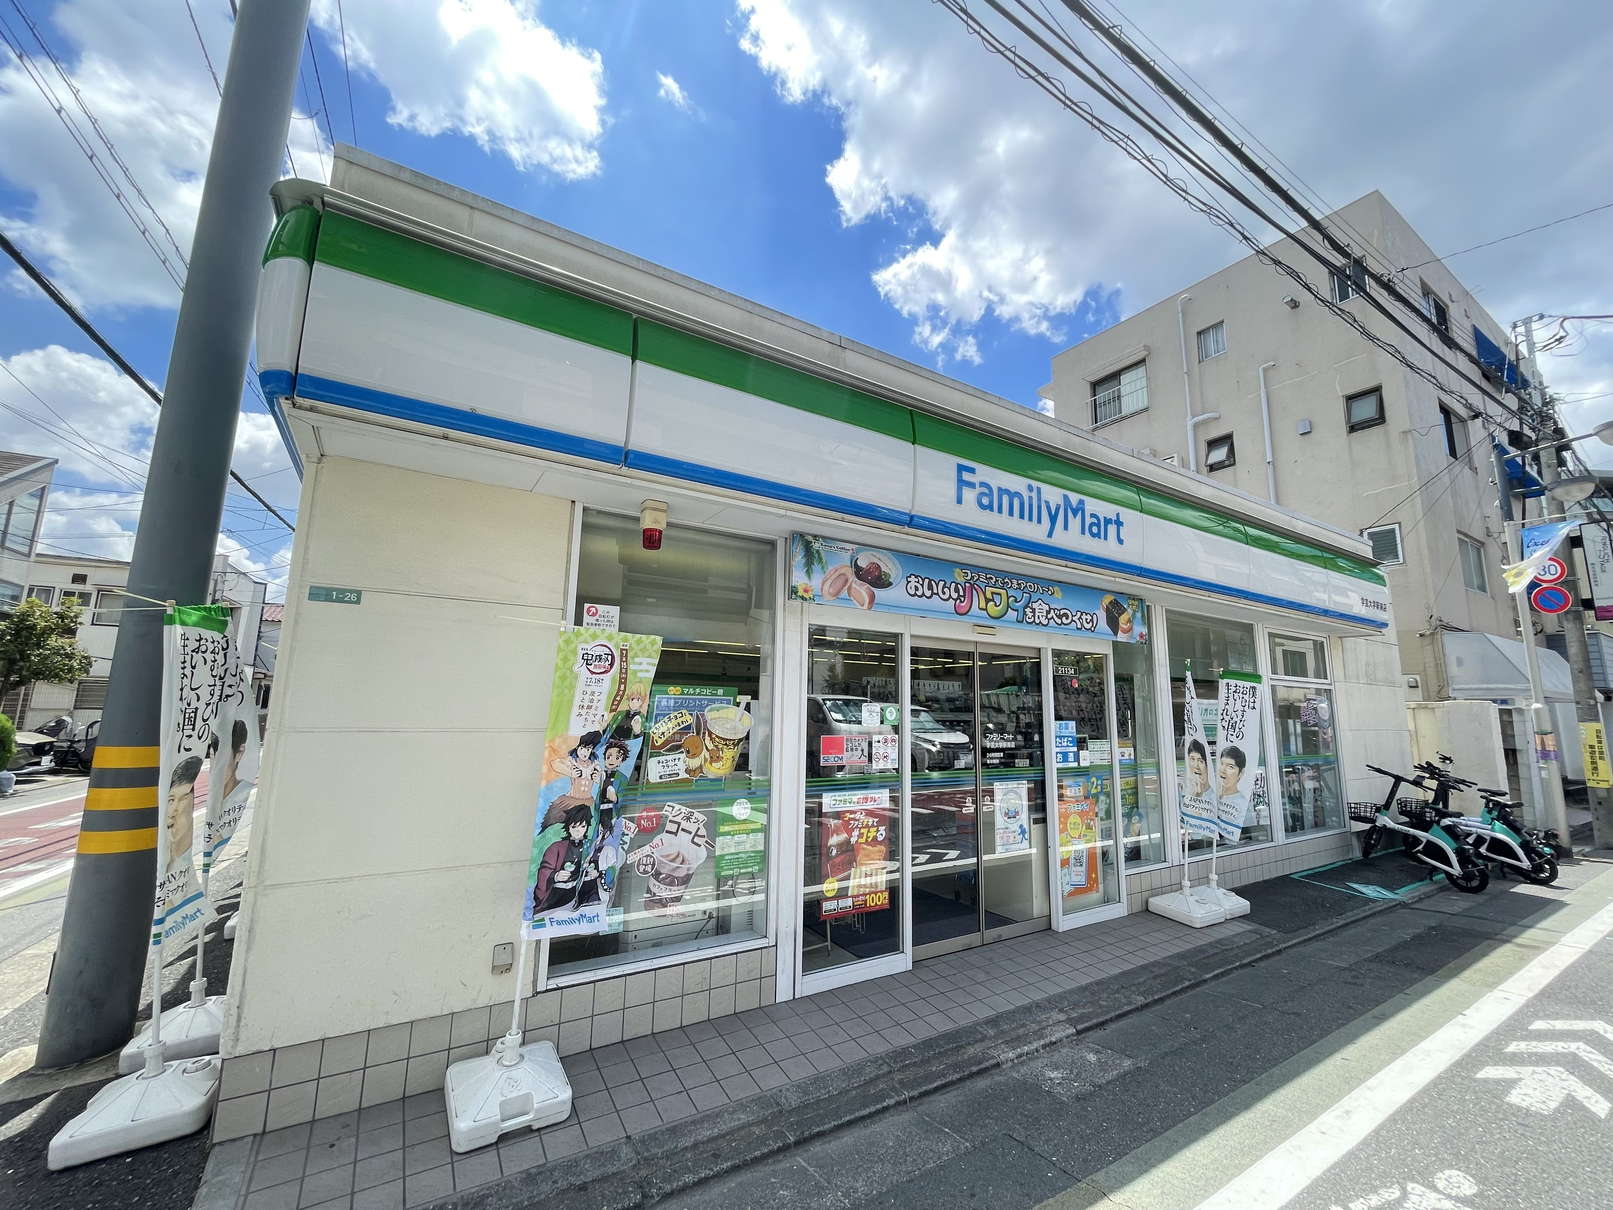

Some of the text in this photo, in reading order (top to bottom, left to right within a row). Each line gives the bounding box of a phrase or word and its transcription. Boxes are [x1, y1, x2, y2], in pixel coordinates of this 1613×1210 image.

[956, 463, 1124, 546] FamilyMart
[1538, 564, 1558, 577] 30
[332, 591, 358, 601] 1-26
[1058, 667, 1075, 675] 21134
[1056, 737, 1073, 747] たばこ
[640, 818, 657, 828] No.1
[665, 820, 716, 849] コーヒー
[164, 907, 204, 939] amilyMart
[548, 912, 600, 927] FamilyMart
